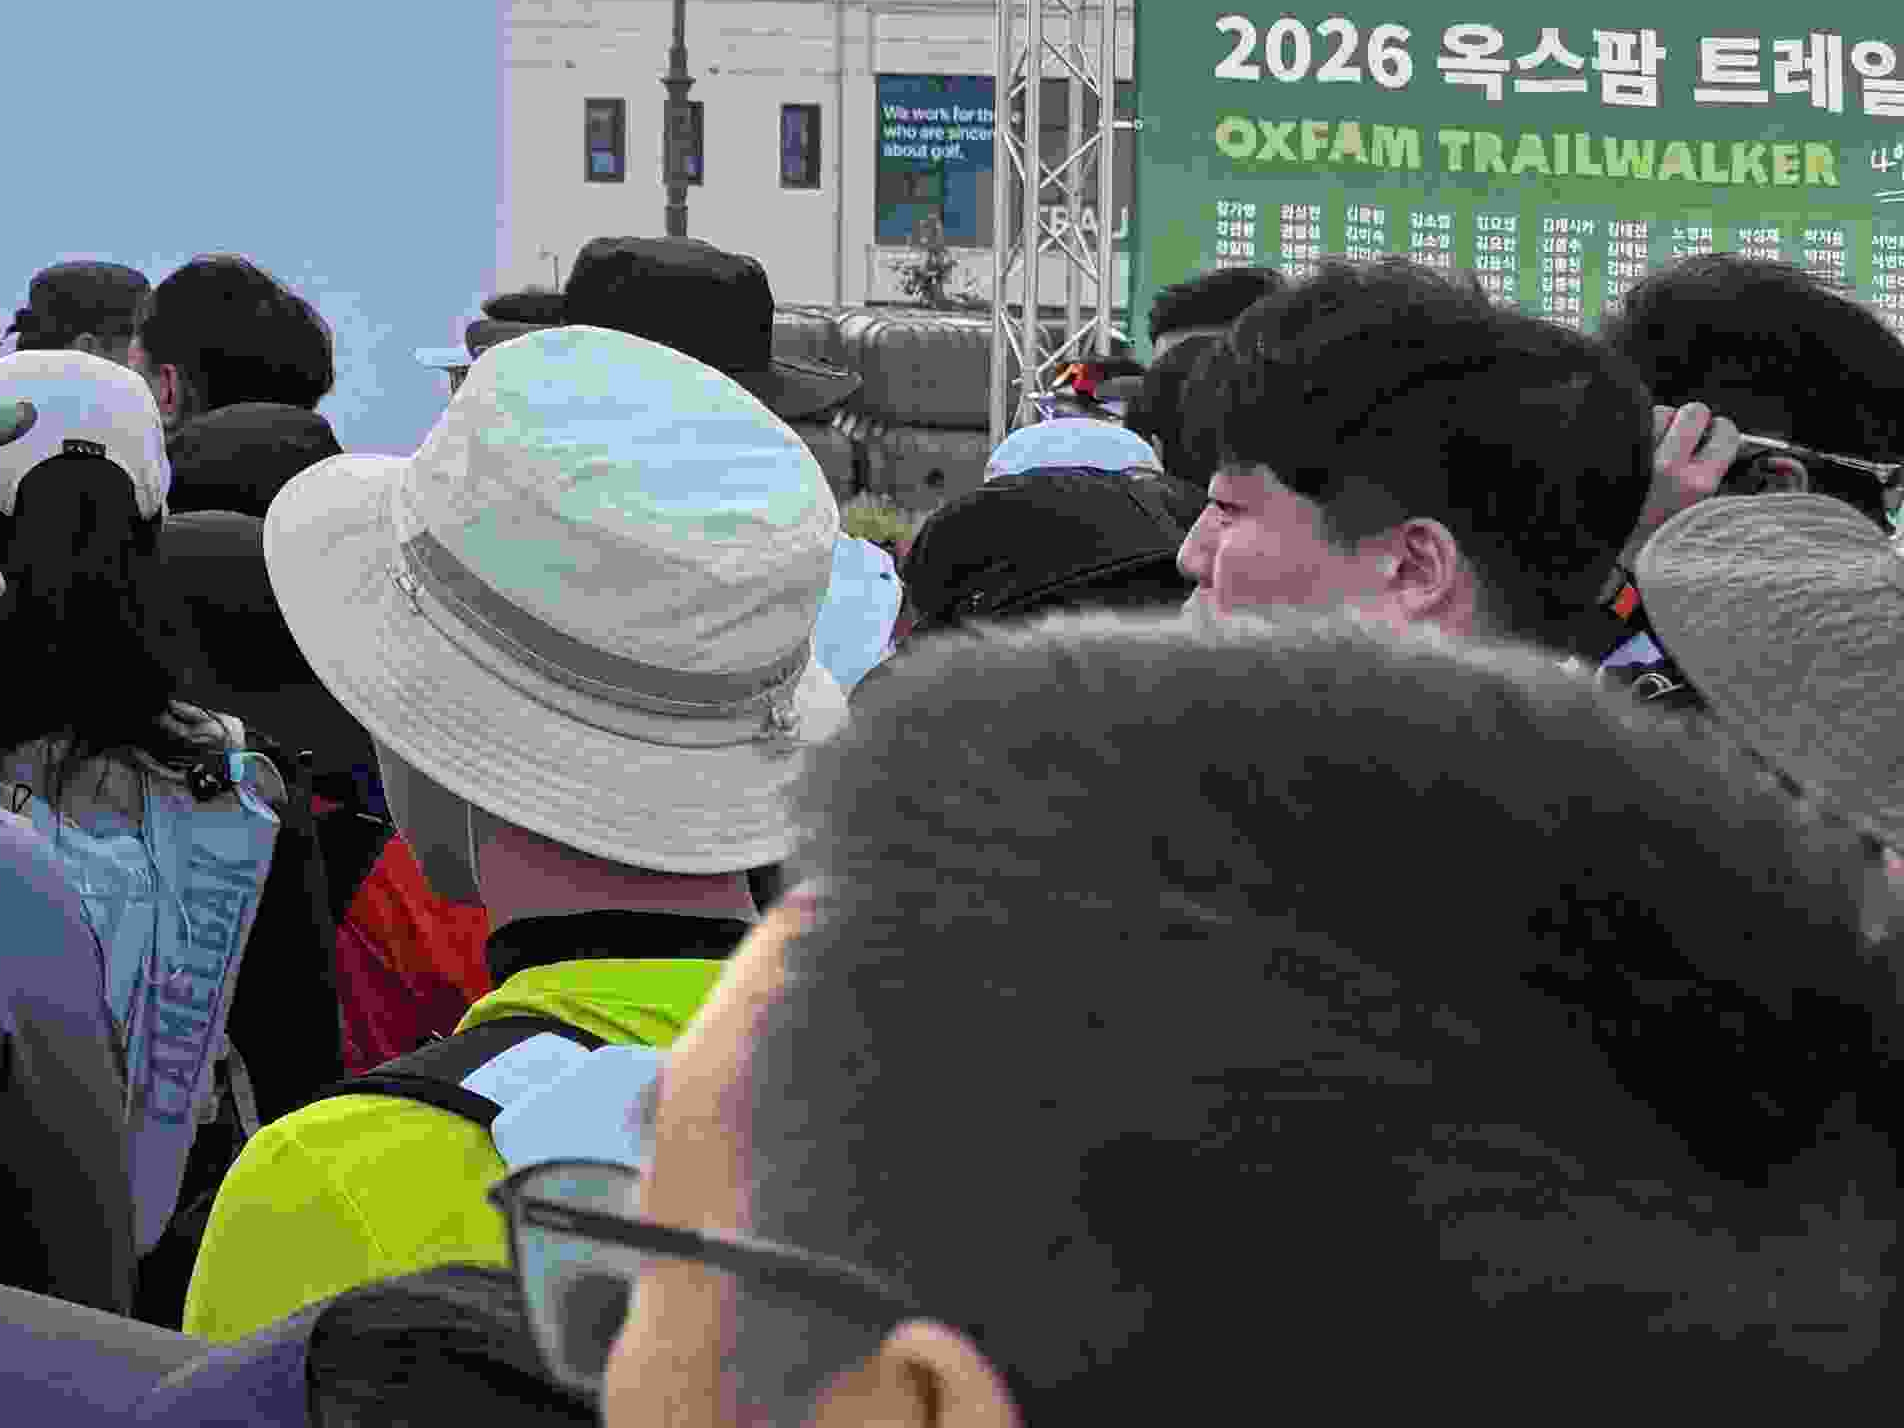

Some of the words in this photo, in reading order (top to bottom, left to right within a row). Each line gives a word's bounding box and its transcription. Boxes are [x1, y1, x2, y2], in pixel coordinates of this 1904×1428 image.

[1214, 15, 1414, 90] 2026
[1438, 23, 1666, 110] 옥스팜
[882, 103, 909, 121] We
[911, 106, 950, 121] work
[953, 103, 976, 122] for
[882, 123, 916, 139] who
[920, 126, 943, 141] are
[944, 126, 995, 143] sincer
[882, 142, 928, 158] about
[1215, 113, 1421, 174] OXFAM
[1439, 128, 1840, 190] TRAILWALKER
